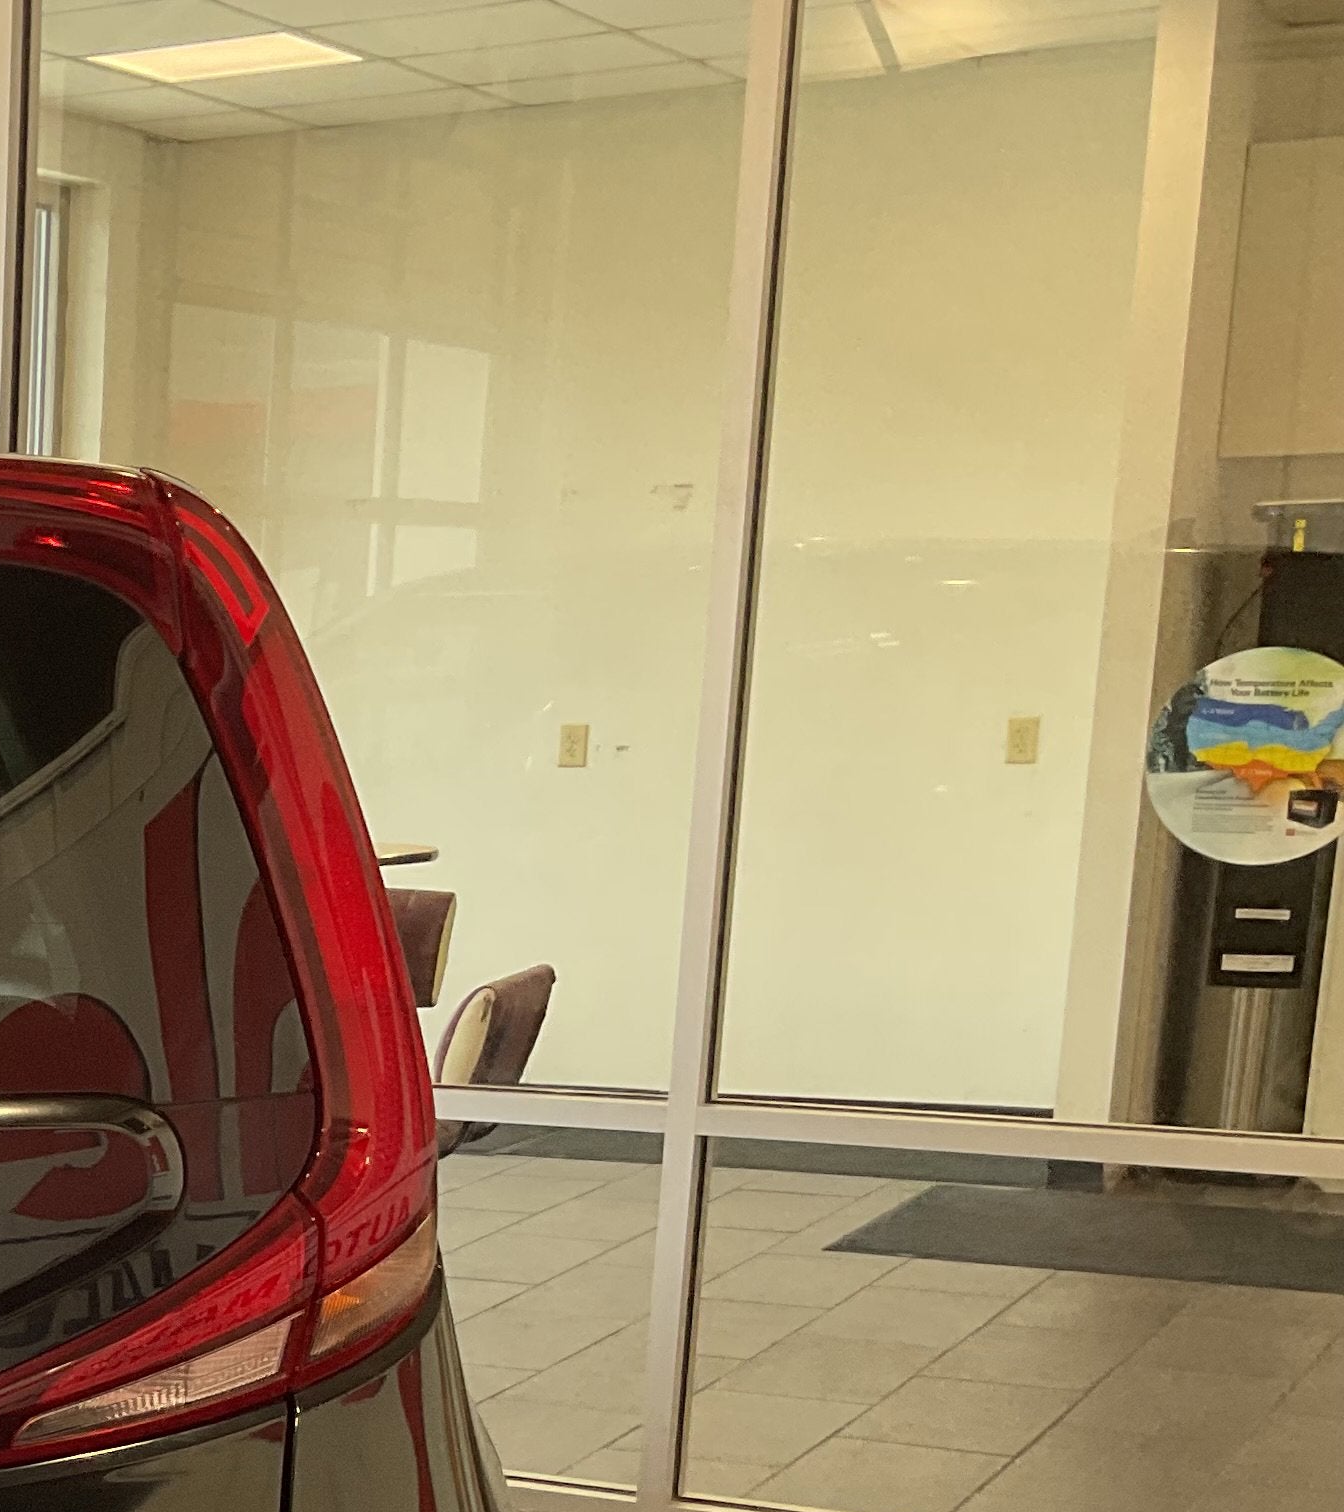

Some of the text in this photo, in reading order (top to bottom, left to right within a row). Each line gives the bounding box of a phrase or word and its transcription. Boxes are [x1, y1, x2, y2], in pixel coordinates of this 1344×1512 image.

[1235, 679, 1296, 688] Temperature
[1299, 680, 1334, 688] Affects
[1231, 688, 1311, 698] Your Battery Life
